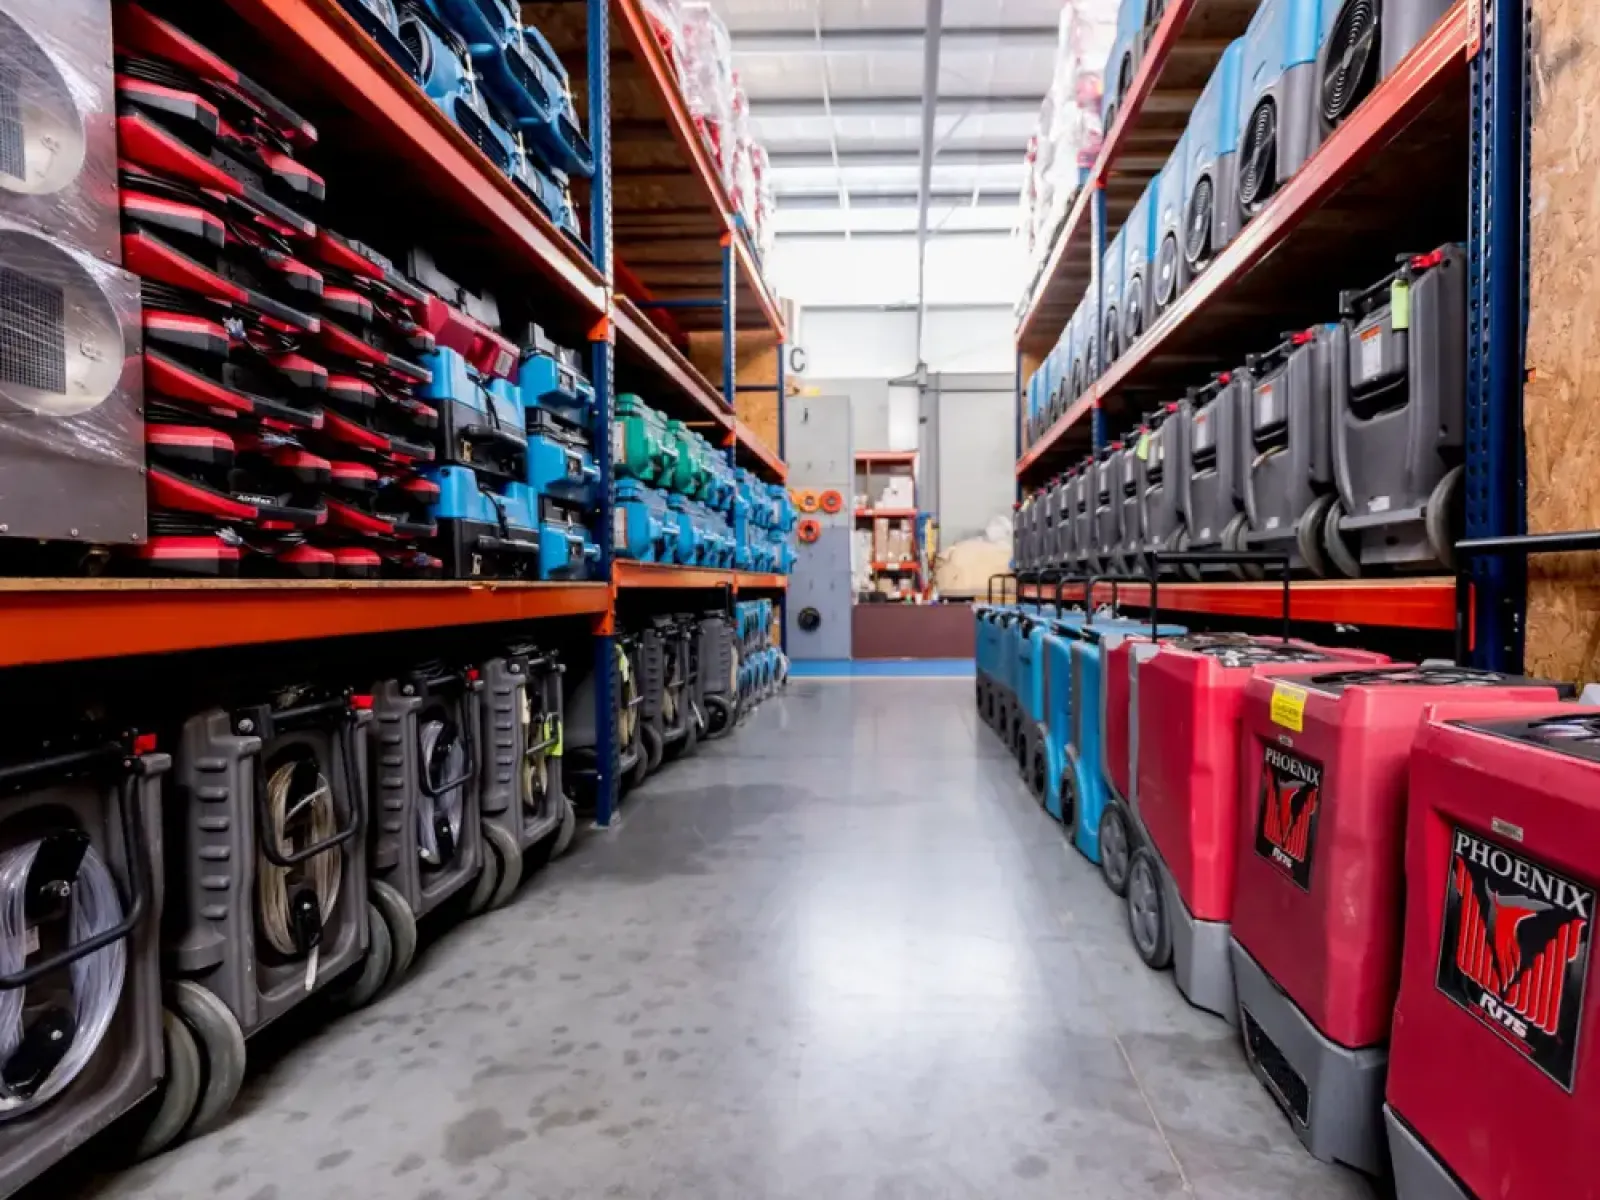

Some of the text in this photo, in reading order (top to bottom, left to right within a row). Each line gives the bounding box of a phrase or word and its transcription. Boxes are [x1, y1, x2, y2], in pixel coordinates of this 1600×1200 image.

[790, 347, 805, 373] C
[1265, 747, 1320, 786] PHOENIX
[1455, 832, 1591, 918] PHOENIX
